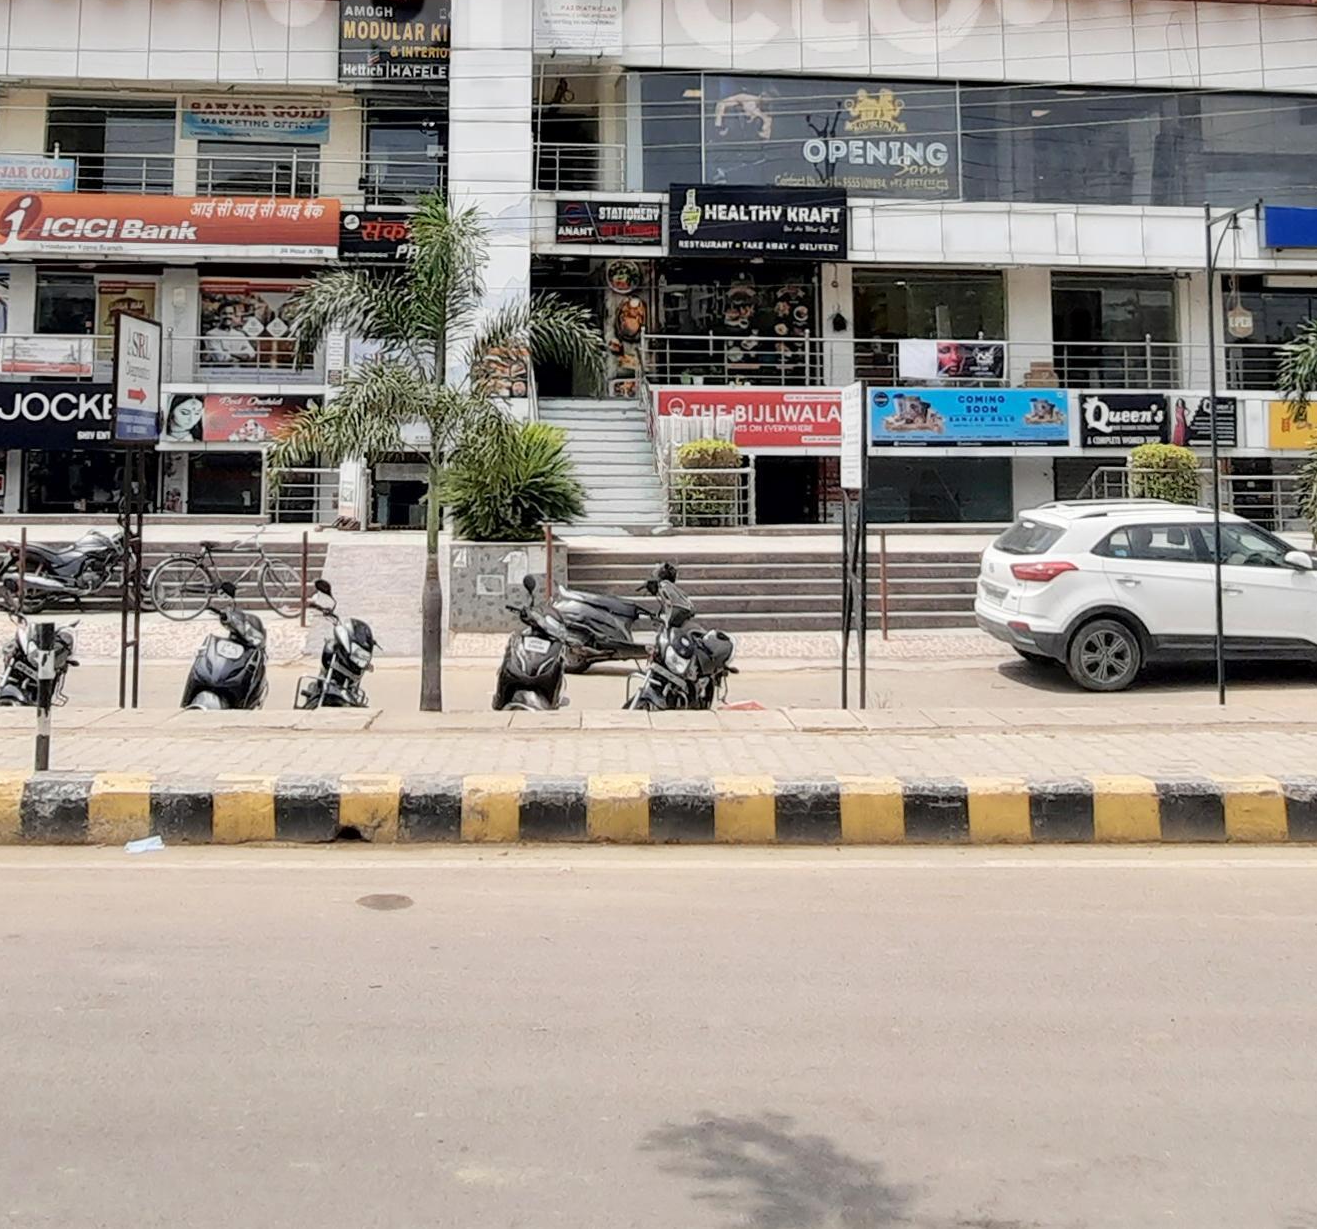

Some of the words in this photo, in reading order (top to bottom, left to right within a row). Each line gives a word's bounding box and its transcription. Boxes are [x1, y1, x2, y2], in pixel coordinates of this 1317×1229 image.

[344, 6, 393, 18] AMOGH
[343, 20, 425, 42] MODULAR
[389, 45, 399, 58] &
[401, 45, 451, 59] INTERIO
[343, 63, 384, 77] Hettich
[190, 102, 266, 118] SANJAR
[272, 105, 326, 120] GOLD
[201, 118, 269, 128] MARKETING
[802, 139, 950, 167] OPENING
[31, 166, 72, 181] GOLD
[190, 198, 215, 218] आई
[217, 198, 234, 219] सी
[234, 199, 260, 220] आई
[260, 198, 277, 220] सी
[277, 199, 302, 220] आई
[303, 198, 325, 220] बैंक
[597, 206, 661, 222] STATIONERY
[704, 204, 783, 222] HEALTHY
[786, 207, 841, 224] KRAFT
[40, 217, 115, 239] ICICI
[120, 220, 198, 241] Bank
[558, 226, 594, 237] ANANT
[678, 240, 733, 250] RESTAURANT
[742, 241, 764, 250] TAKE
[765, 242, 789, 251] AWAY
[799, 243, 840, 252] DELIVERY
[246, 396, 283, 407] Orchid
[958, 395, 1006, 404] COMING
[690, 404, 727, 416] THE
[734, 404, 842, 422] BIJLIWALA
[966, 405, 998, 414] SOON
[1083, 396, 1165, 434] Queen's
